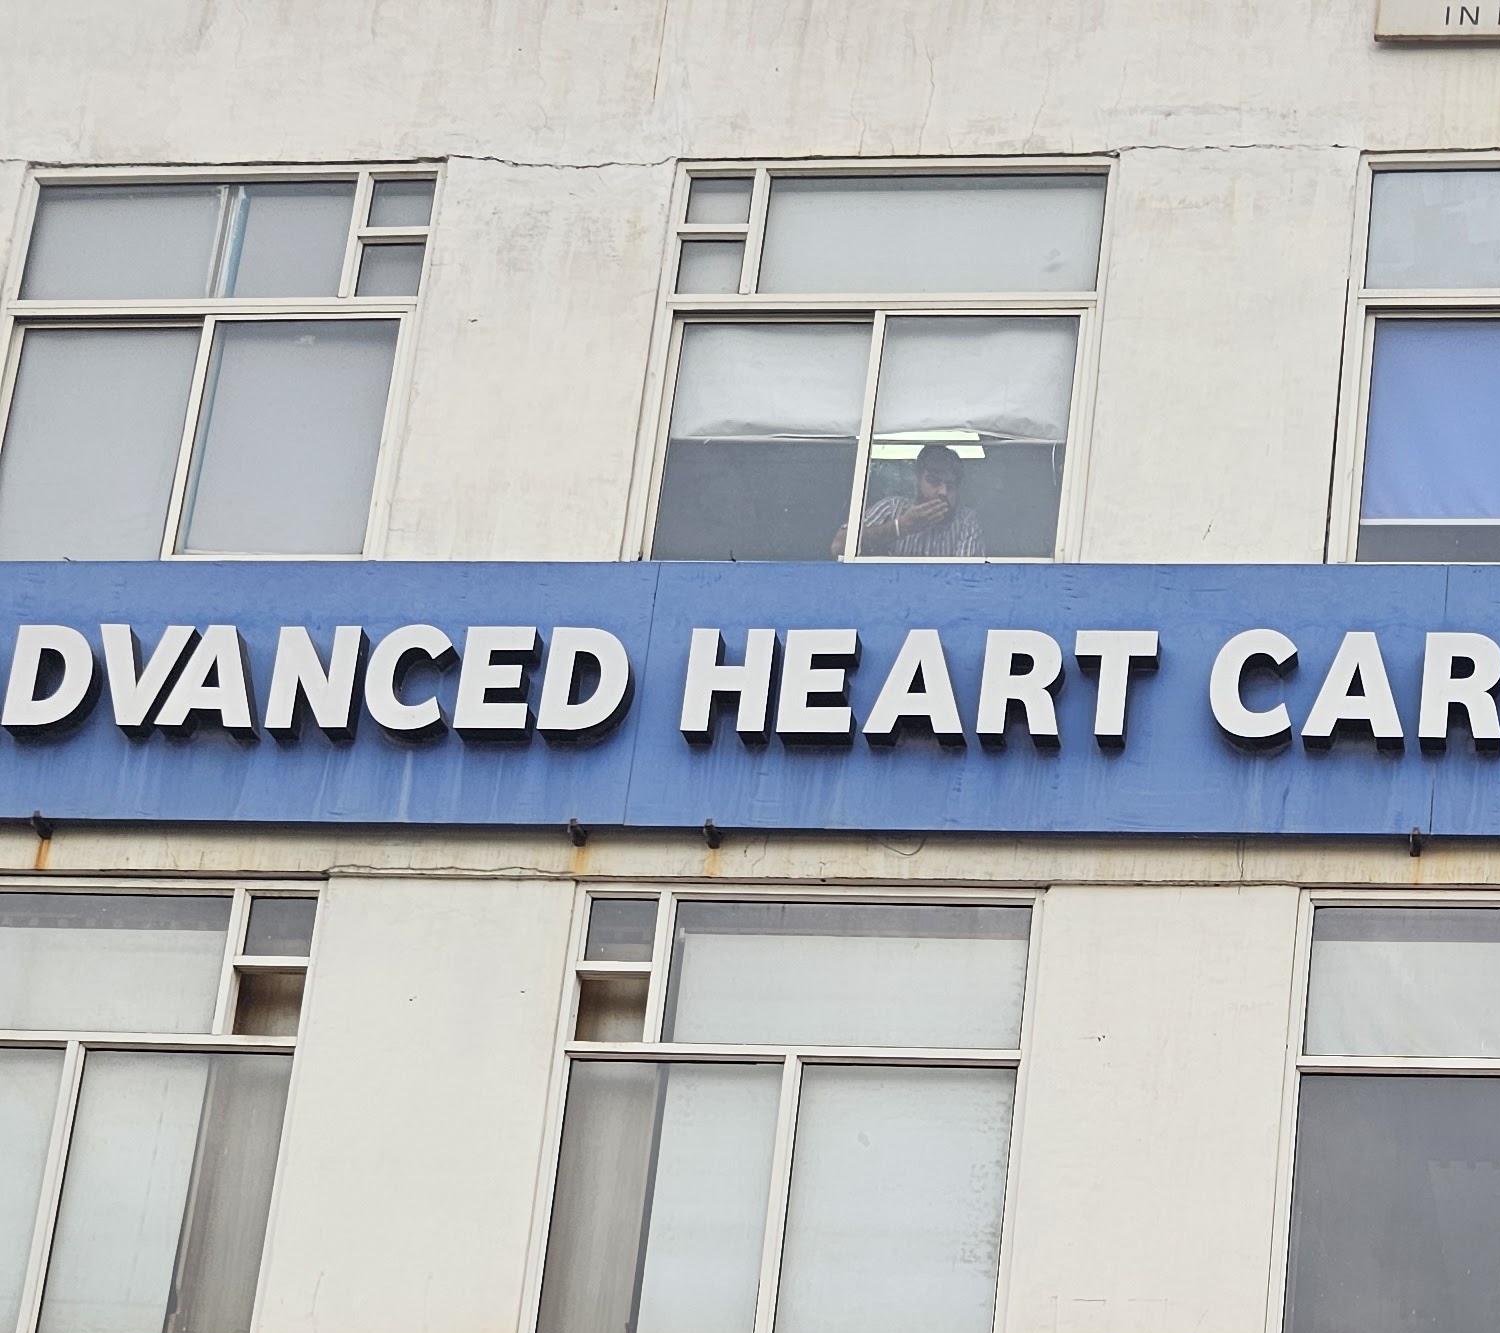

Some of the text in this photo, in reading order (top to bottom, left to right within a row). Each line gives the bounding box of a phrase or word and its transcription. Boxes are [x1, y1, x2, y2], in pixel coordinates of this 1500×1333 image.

[1445, 6, 1480, 26] IN
[2, 624, 637, 742] DVANCED
[679, 628, 1160, 750] HEART
